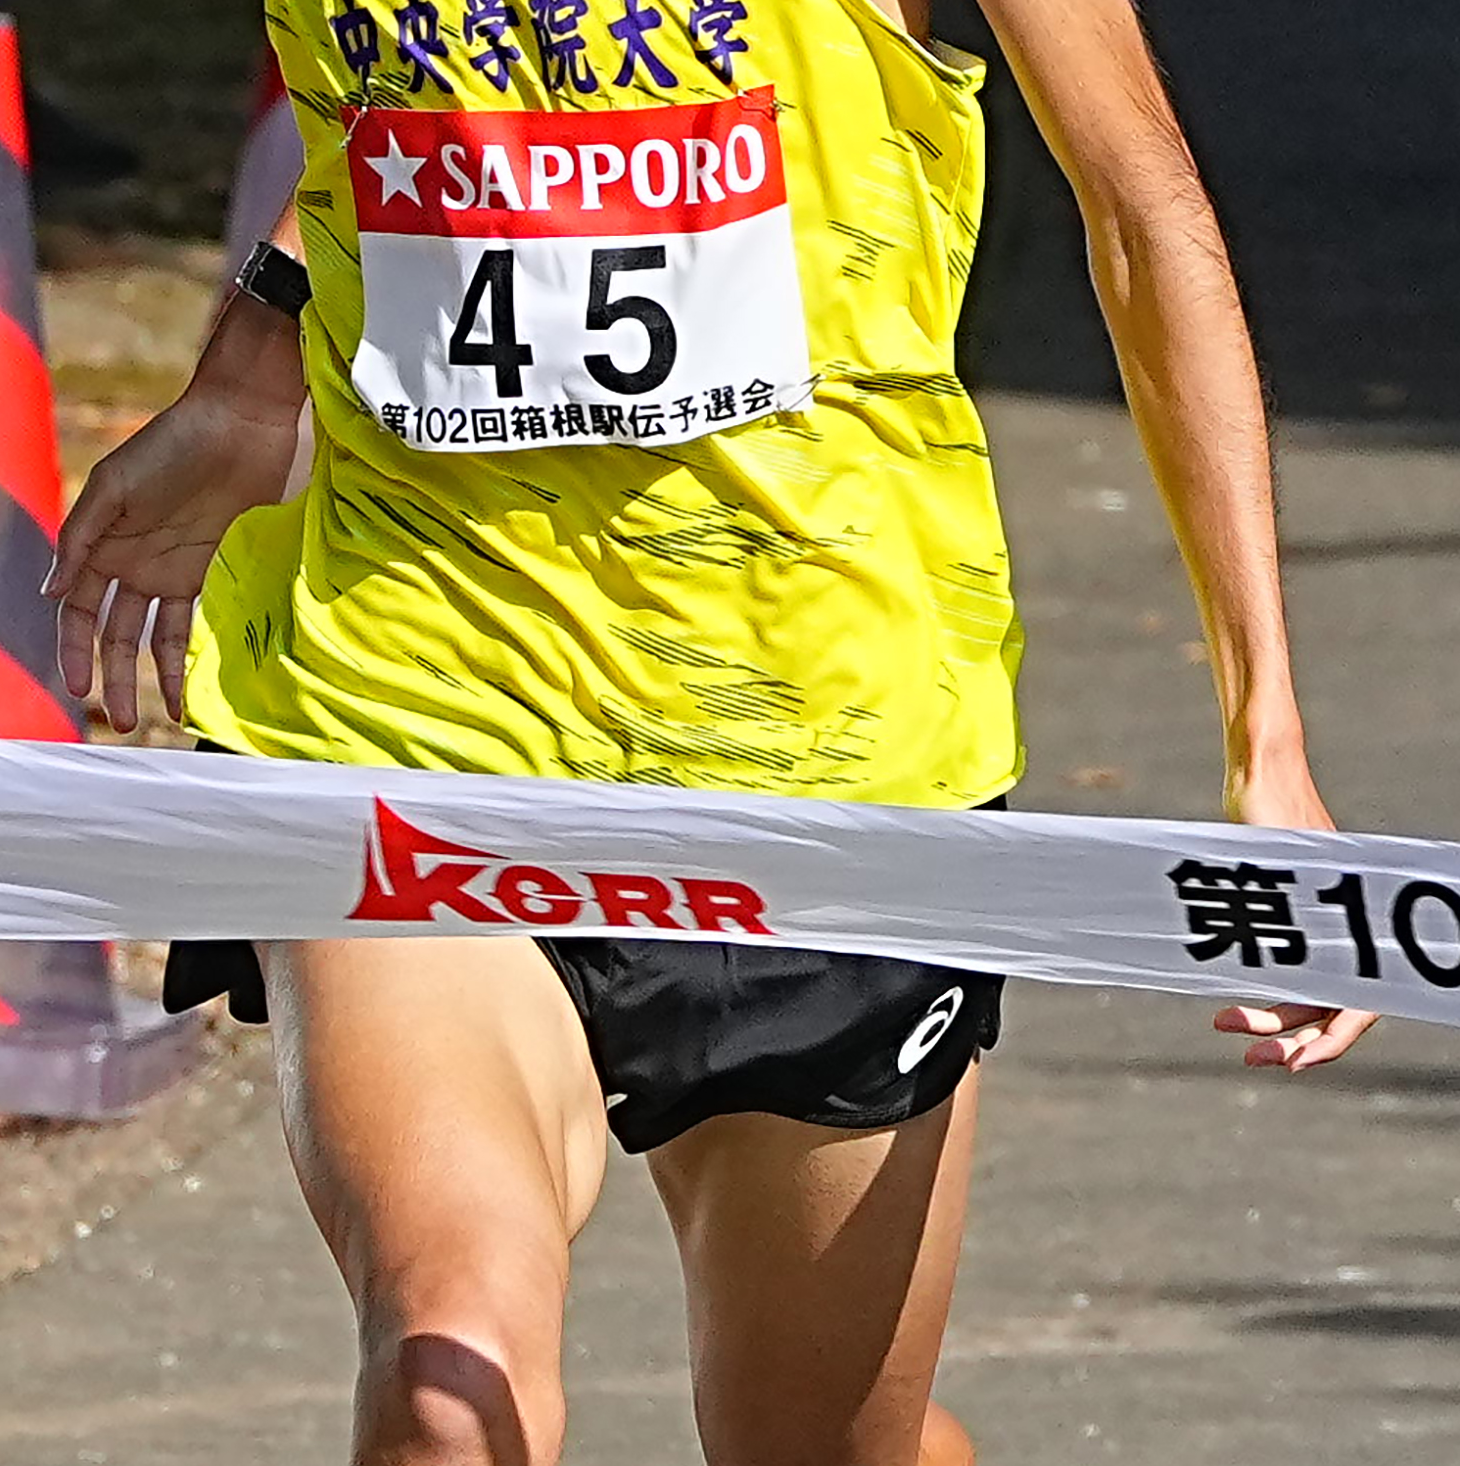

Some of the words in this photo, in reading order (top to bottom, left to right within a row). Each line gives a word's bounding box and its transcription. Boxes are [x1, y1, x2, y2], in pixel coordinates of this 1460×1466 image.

[441, 123, 767, 213] SAPPORO
[449, 244, 678, 398] 45
[381, 378, 776, 444] 第102回箱根駅伝予選会
